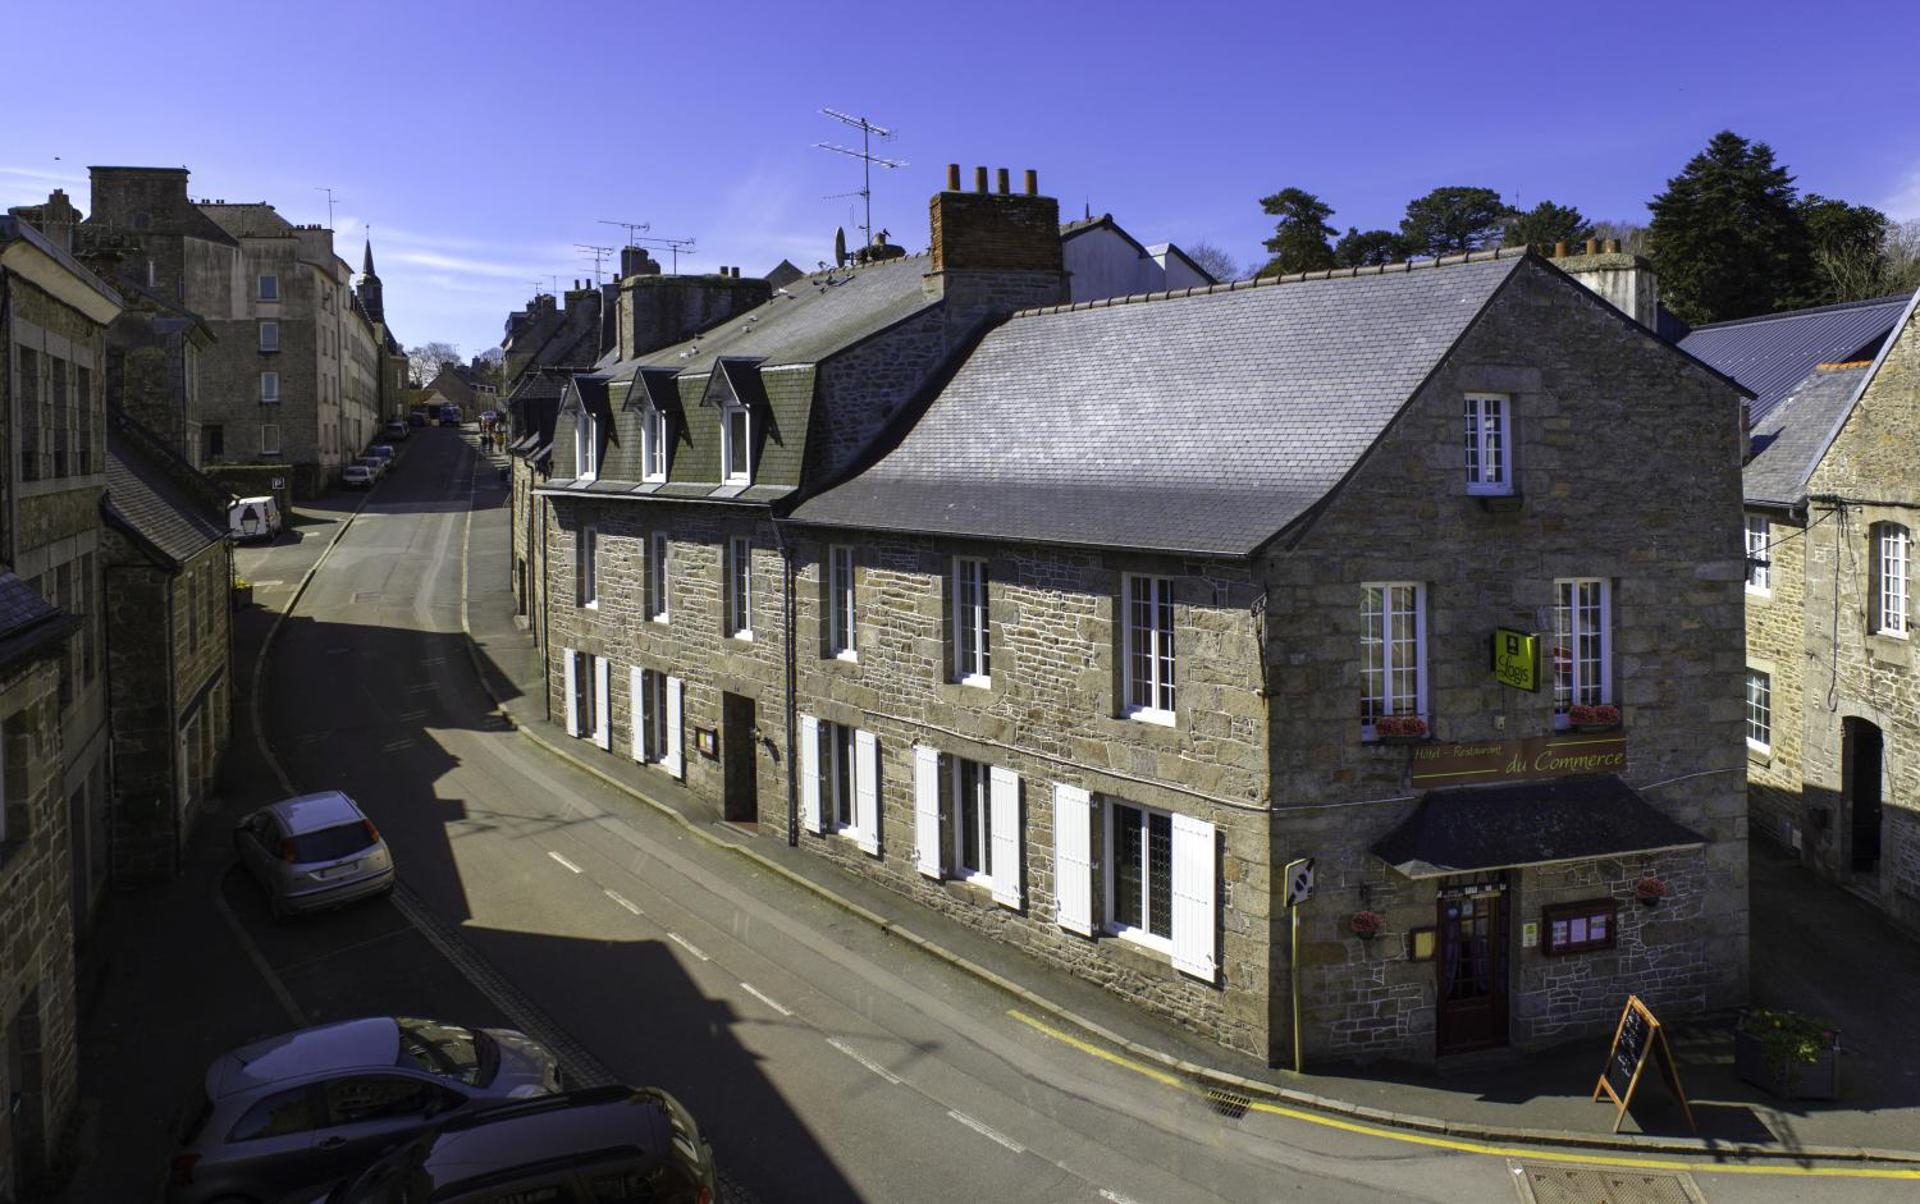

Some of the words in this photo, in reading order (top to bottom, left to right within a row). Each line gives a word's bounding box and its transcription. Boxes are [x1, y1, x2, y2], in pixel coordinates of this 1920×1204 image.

[1453, 744, 1502, 759] Restaurant
[1505, 753, 1527, 773] du
[1535, 750, 1624, 771] Commerce
